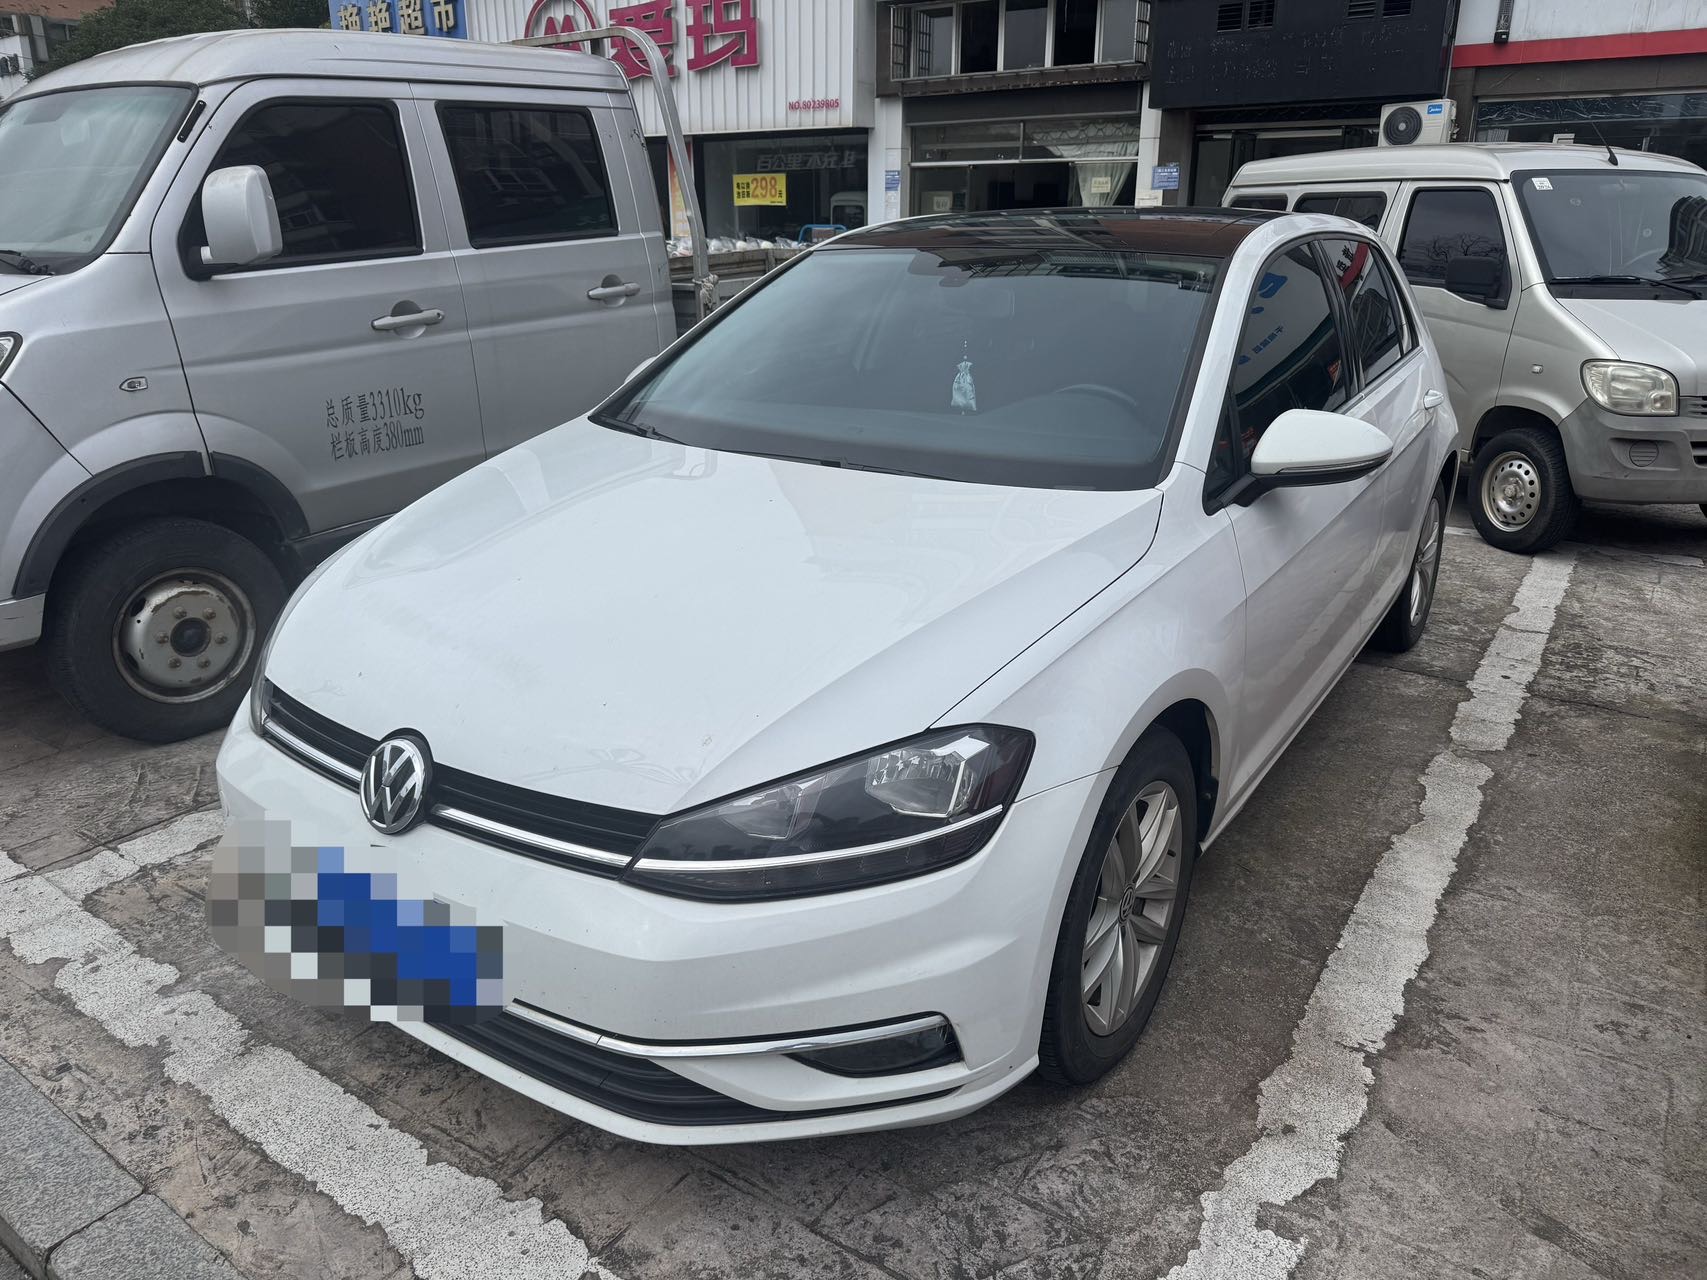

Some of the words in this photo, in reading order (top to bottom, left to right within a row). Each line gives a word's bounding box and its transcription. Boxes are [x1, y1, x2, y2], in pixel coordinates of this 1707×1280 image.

[609, 0, 759, 79] 爱玛
[751, 176, 778, 199] 298
[326, 386, 425, 429] 总质量3310kg
[330, 420, 425, 461] 栏板高度380mm
